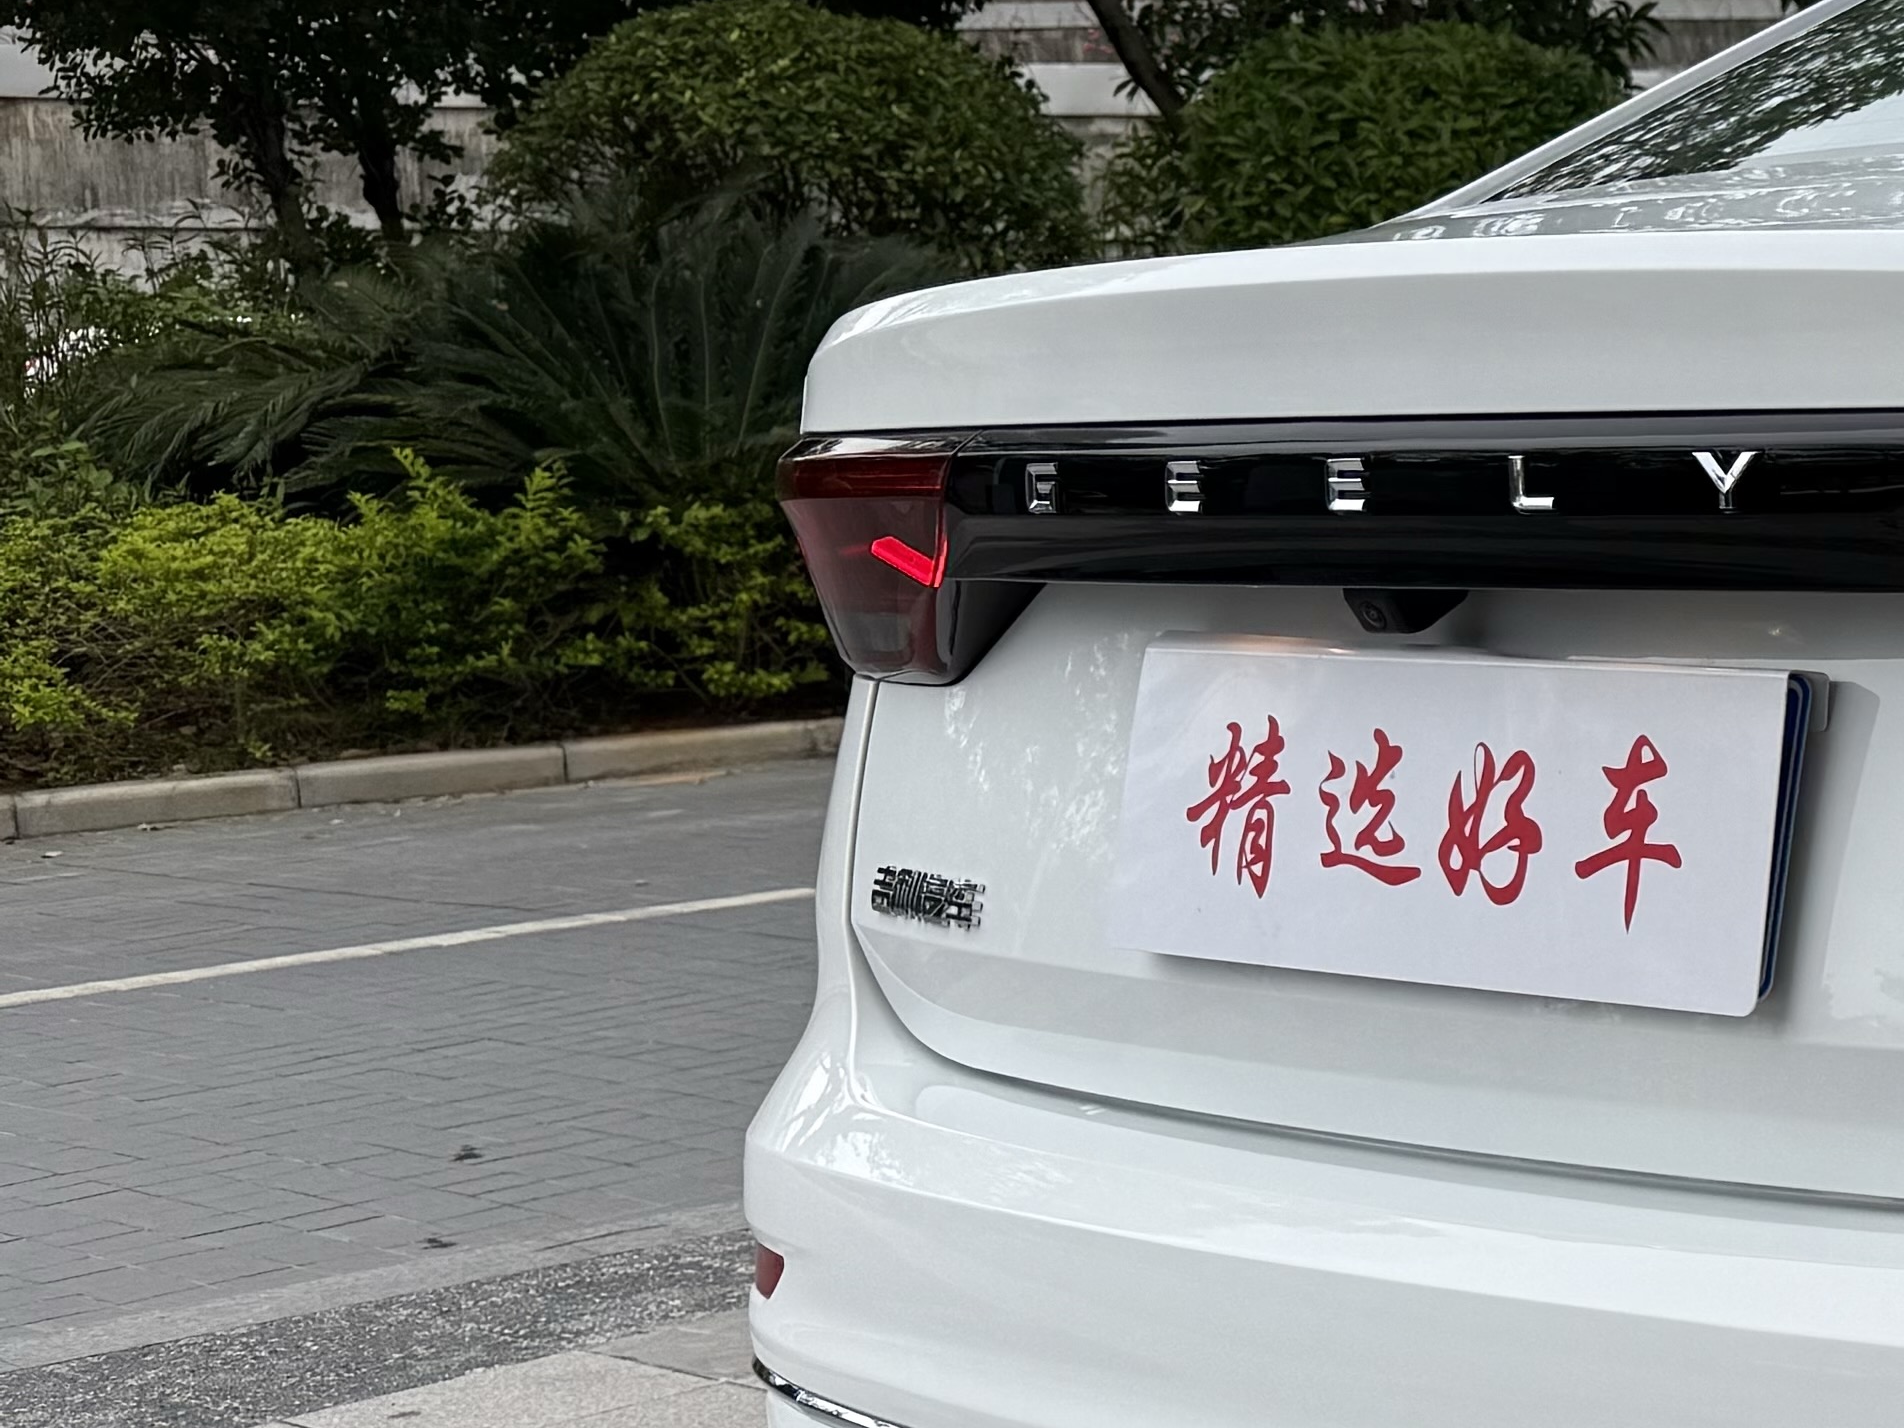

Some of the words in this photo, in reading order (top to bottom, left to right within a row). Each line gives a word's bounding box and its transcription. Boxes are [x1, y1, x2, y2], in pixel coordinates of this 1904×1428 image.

[1025, 451, 1757, 515] GEELY
[1186, 714, 1684, 934] 精选好车
